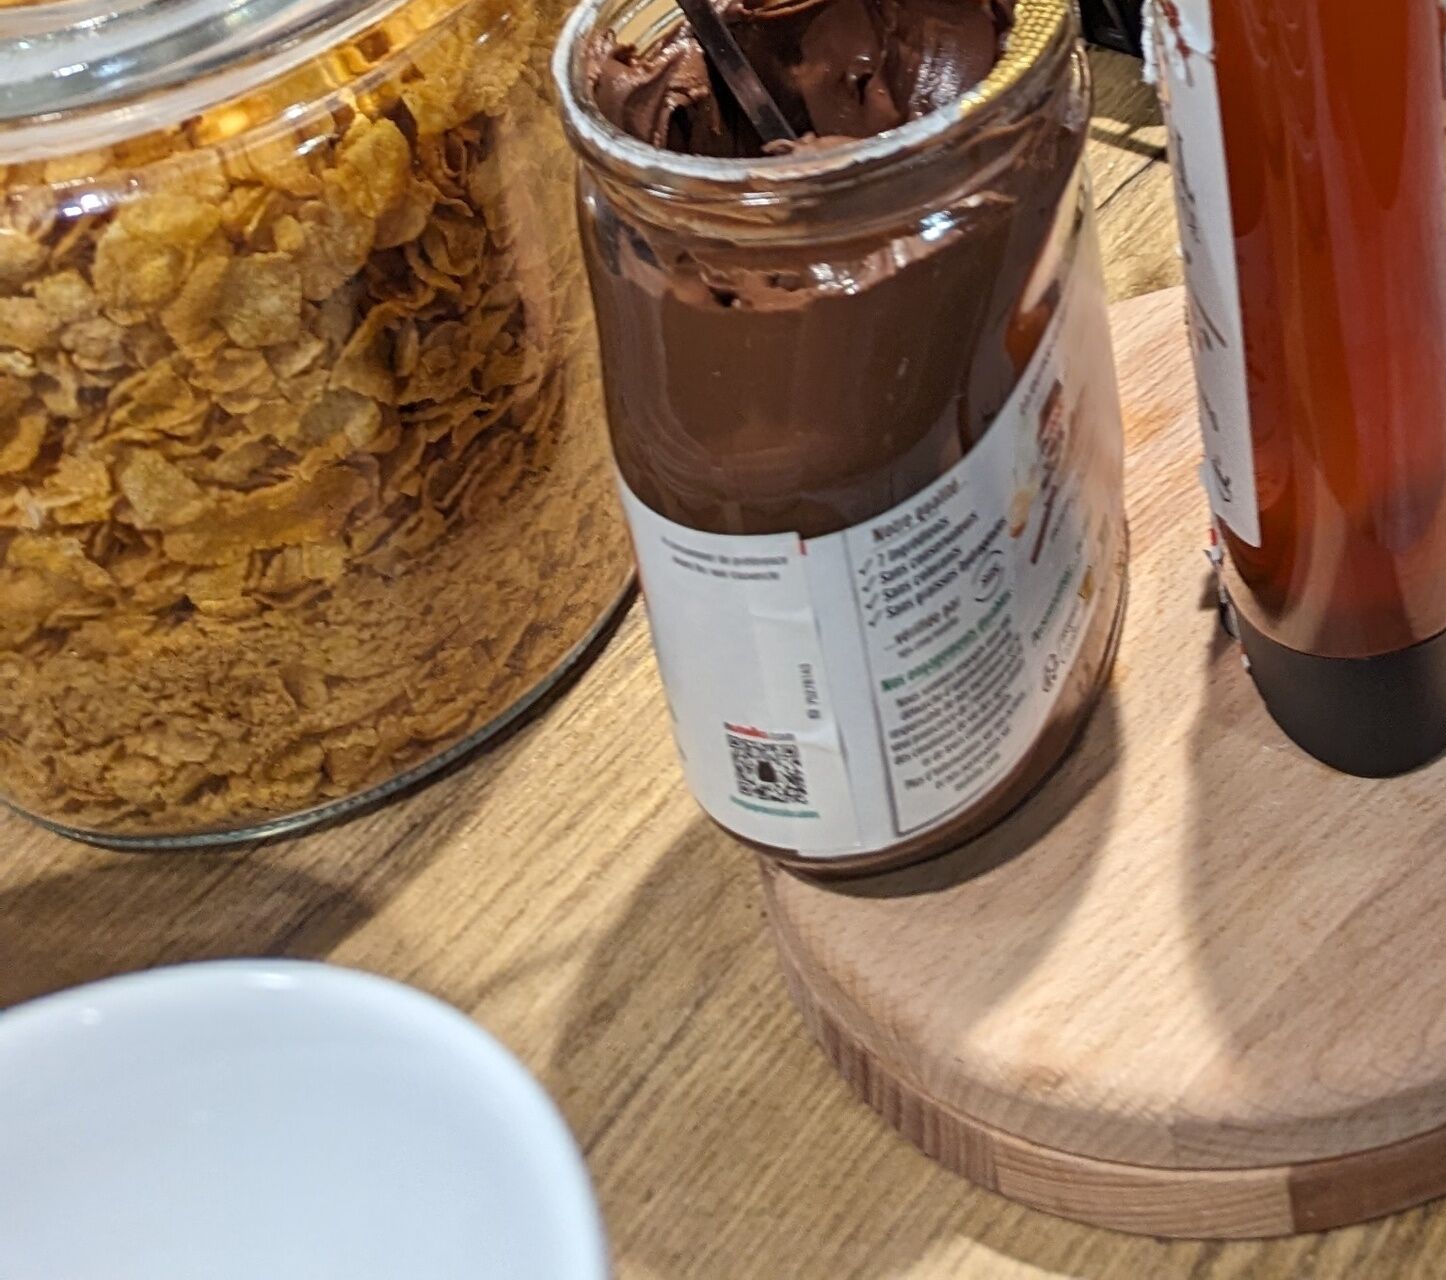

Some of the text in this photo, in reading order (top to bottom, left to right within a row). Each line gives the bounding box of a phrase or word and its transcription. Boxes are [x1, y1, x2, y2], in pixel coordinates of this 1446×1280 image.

[880, 565, 908, 584] Sans
[882, 582, 912, 602] Sans
[886, 600, 915, 619] Sans
